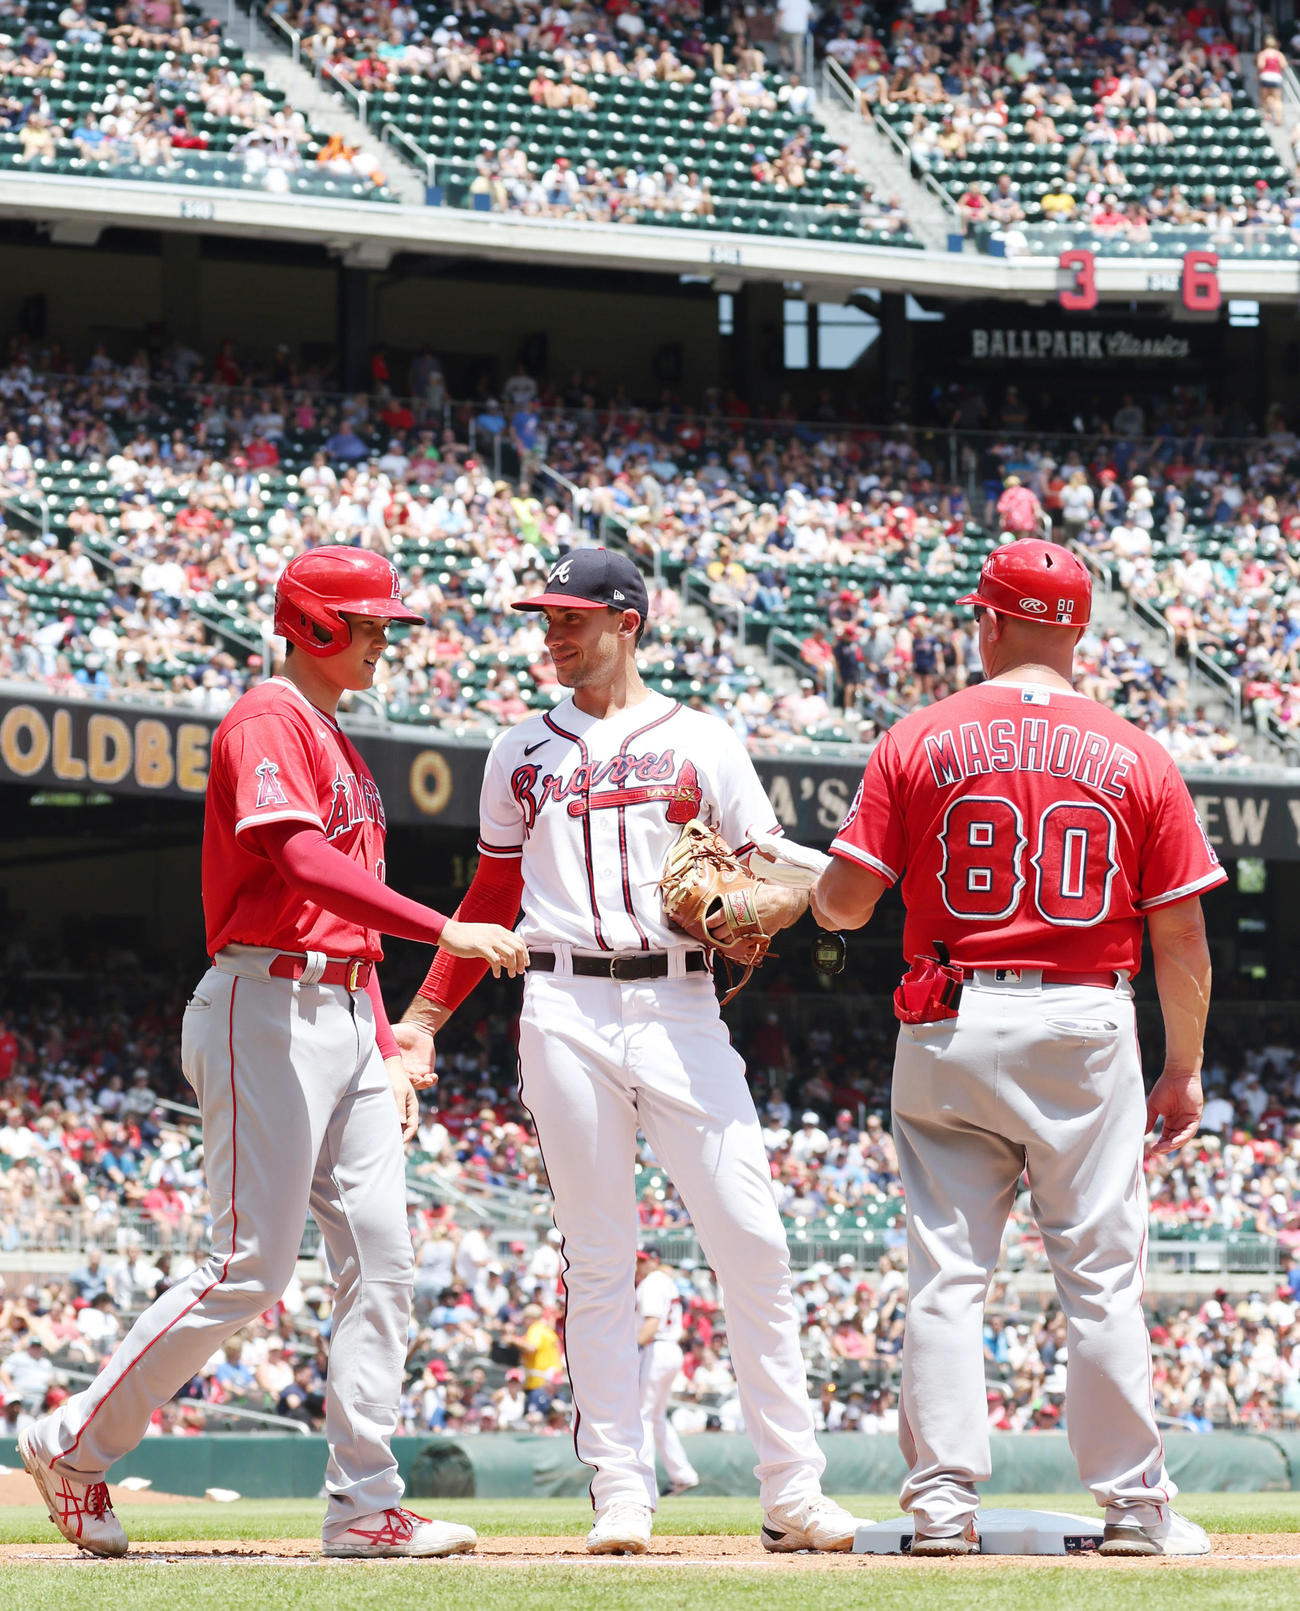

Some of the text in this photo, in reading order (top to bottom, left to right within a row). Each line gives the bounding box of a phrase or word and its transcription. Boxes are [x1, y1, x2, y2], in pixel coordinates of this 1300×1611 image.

[1059, 250, 1097, 310] 3
[1183, 251, 1221, 311] 6
[972, 329, 1189, 358] BALLPARK Classics
[547, 560, 574, 584] A
[1057, 598, 1074, 613] 80
[923, 718, 1137, 799] MASHORE
[511, 749, 675, 839] Braves
[936, 795, 1120, 927] 80
